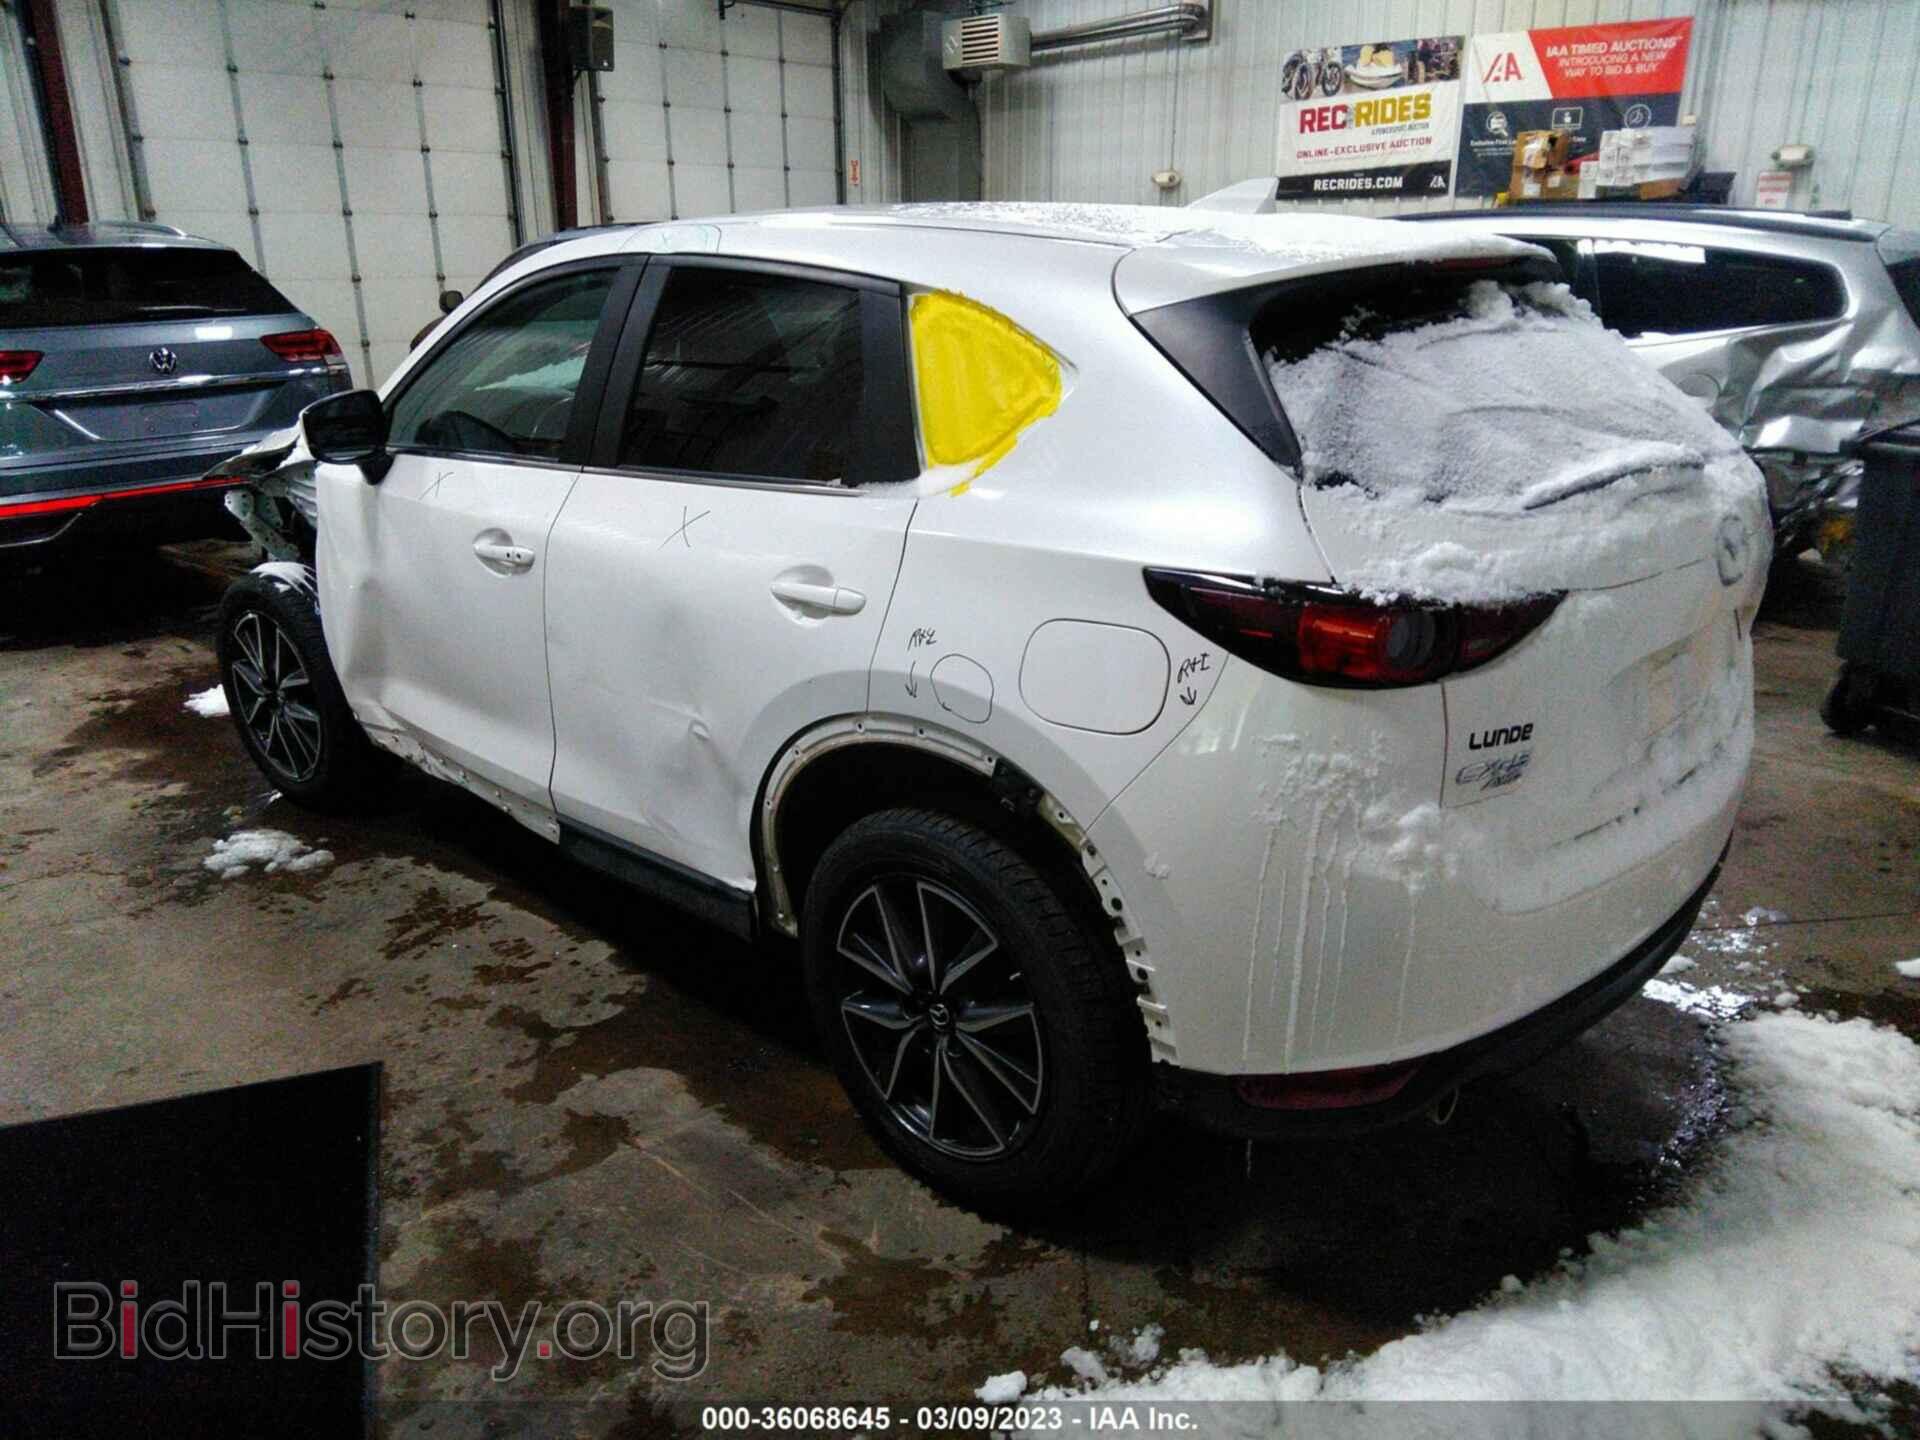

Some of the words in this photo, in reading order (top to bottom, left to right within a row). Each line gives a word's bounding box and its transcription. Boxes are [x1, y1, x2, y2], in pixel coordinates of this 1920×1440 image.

[1300, 104, 1349, 134] REC
[1355, 92, 1432, 128] RIDES
[1296, 142, 1387, 160] ONLINE-EXCLUSIVE
[1390, 136, 1433, 149] AUCTION
[1313, 176, 1403, 191] RECRIDES.COM
